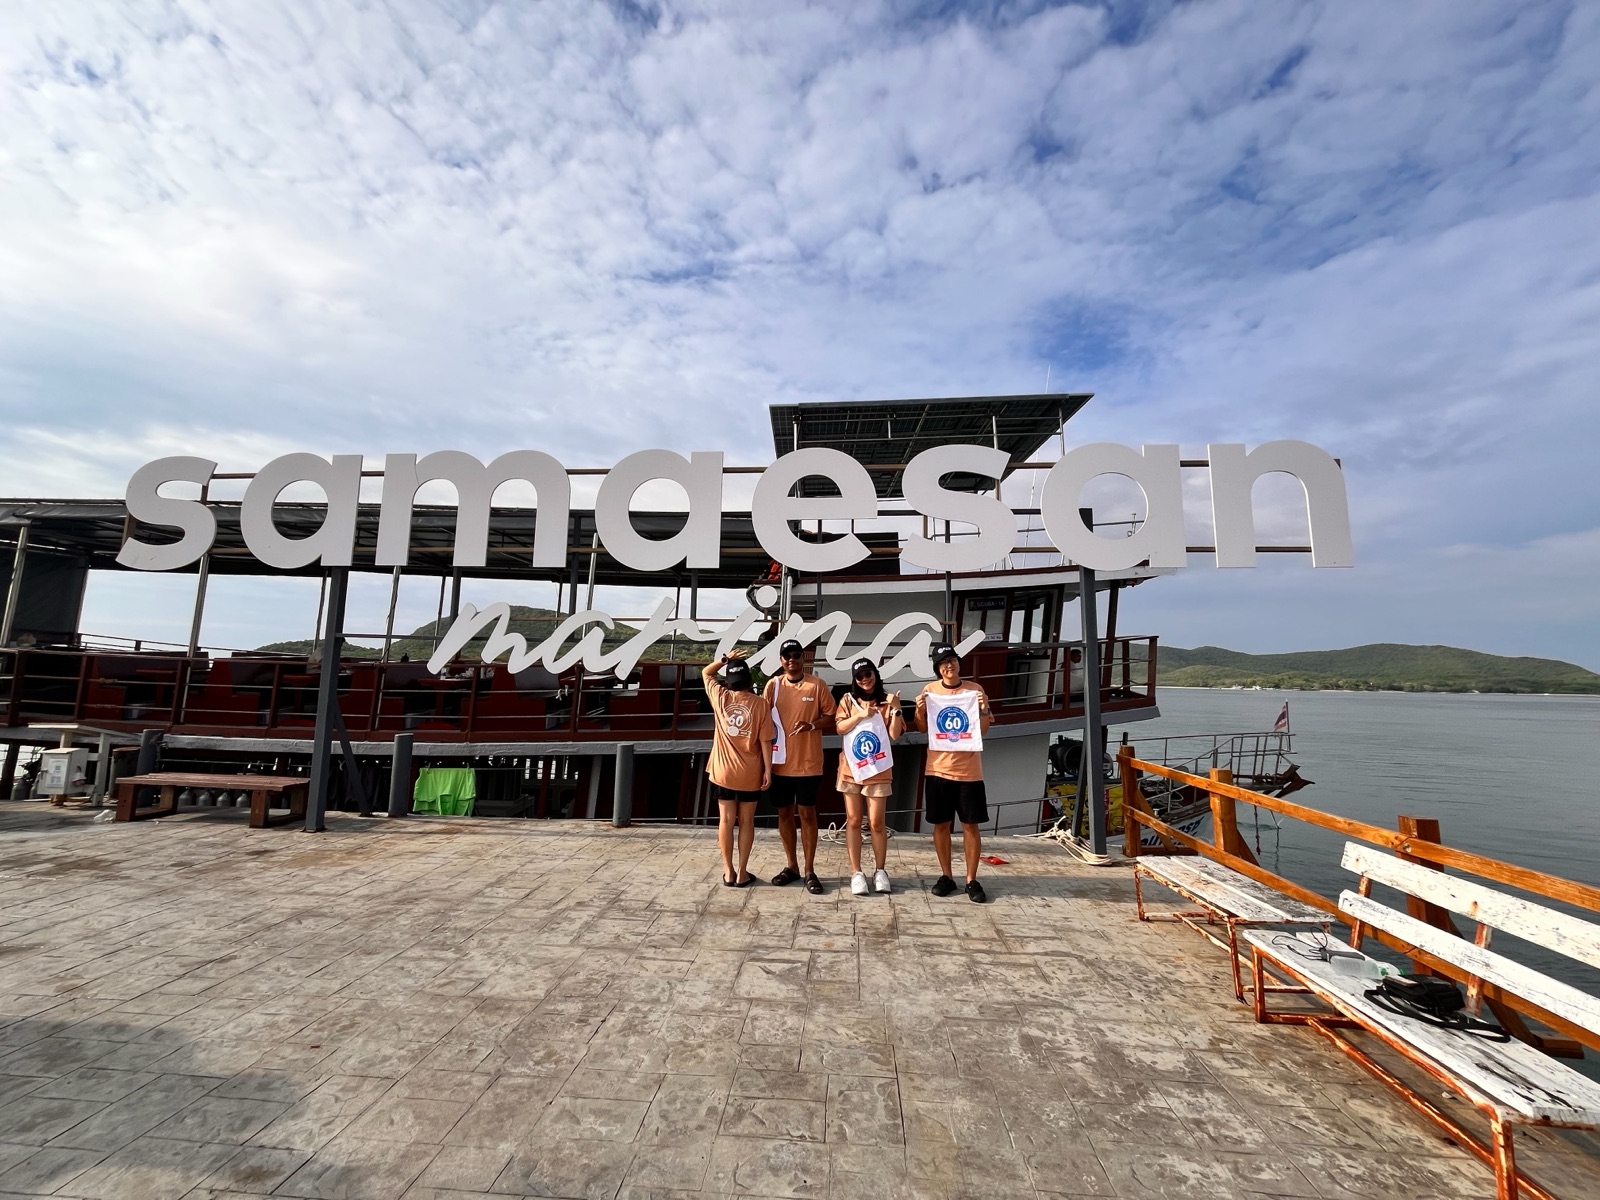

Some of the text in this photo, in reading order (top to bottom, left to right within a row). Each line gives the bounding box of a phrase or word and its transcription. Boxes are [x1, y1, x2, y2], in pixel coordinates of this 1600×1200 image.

[115, 439, 1355, 572] samaesan
[426, 585, 986, 681] marina
[728, 714, 744, 727] 60
[945, 717, 961, 730] 60
[860, 740, 874, 755] 60
